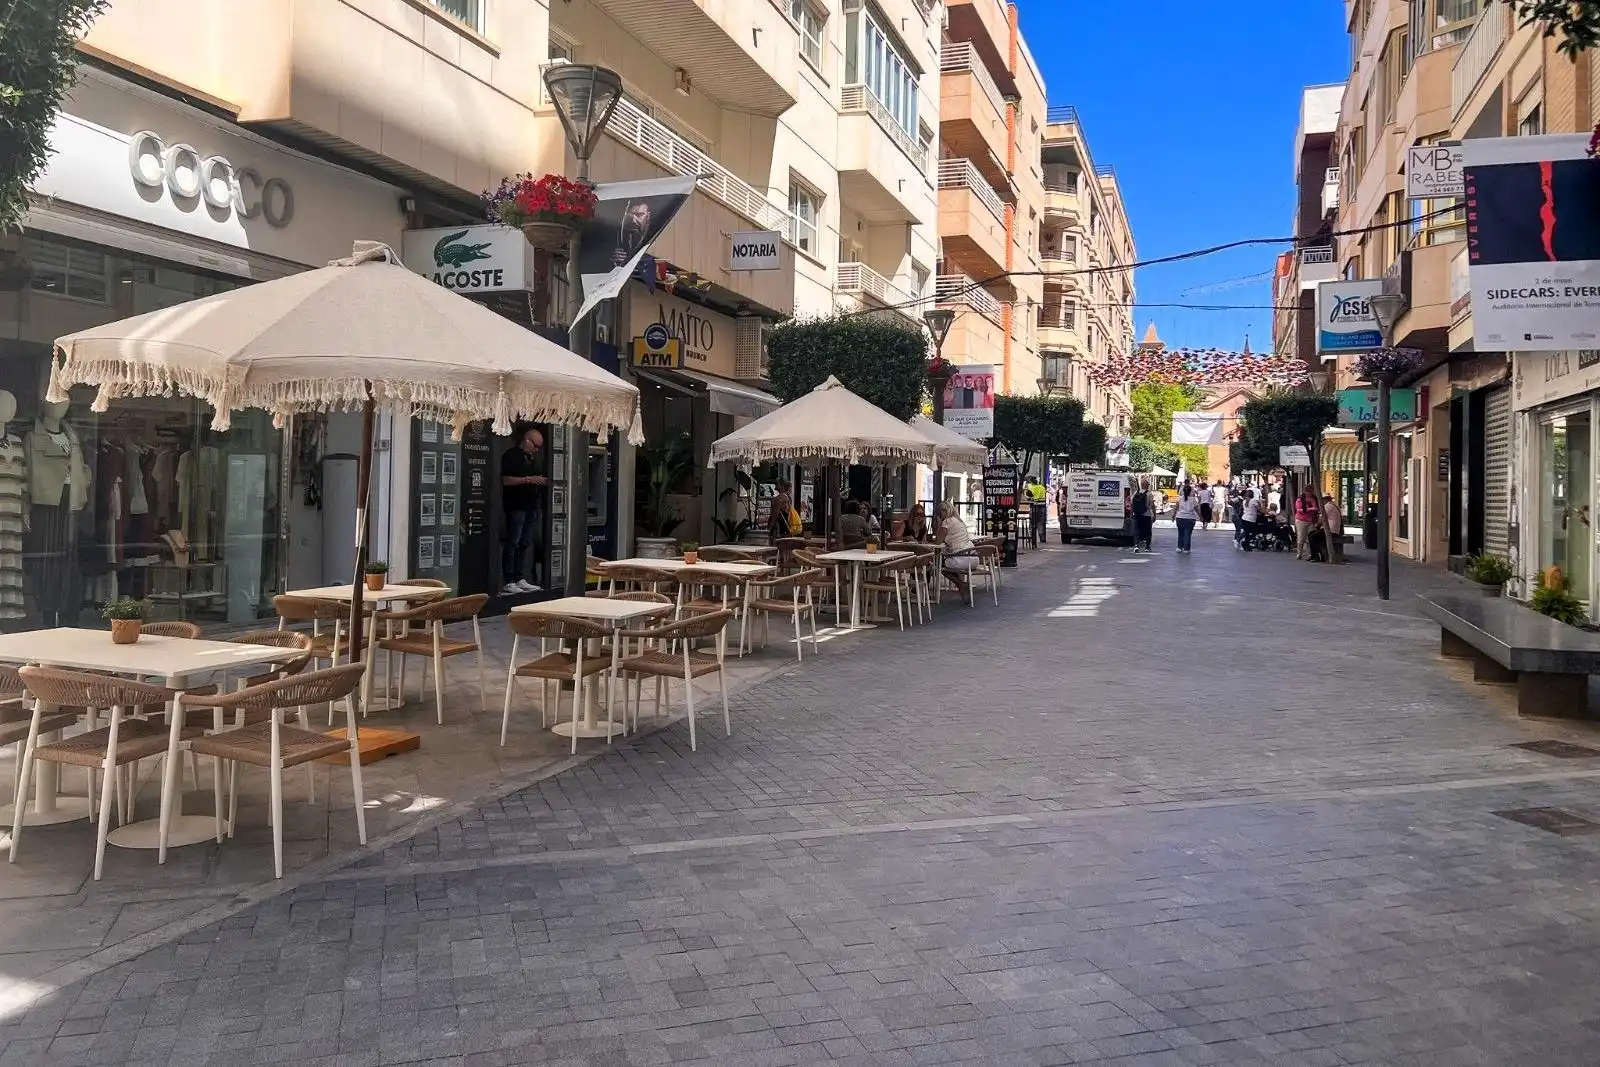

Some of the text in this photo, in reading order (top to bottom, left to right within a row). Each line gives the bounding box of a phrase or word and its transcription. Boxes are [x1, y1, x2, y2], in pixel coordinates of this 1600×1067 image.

[1412, 148, 1453, 171] MB
[1466, 173, 1480, 260] EVEREST
[732, 243, 777, 258] NOTARIA
[422, 269, 504, 289] ACOSTE
[1487, 287, 1560, 300] SIDECARS:
[641, 353, 672, 366] ATM
